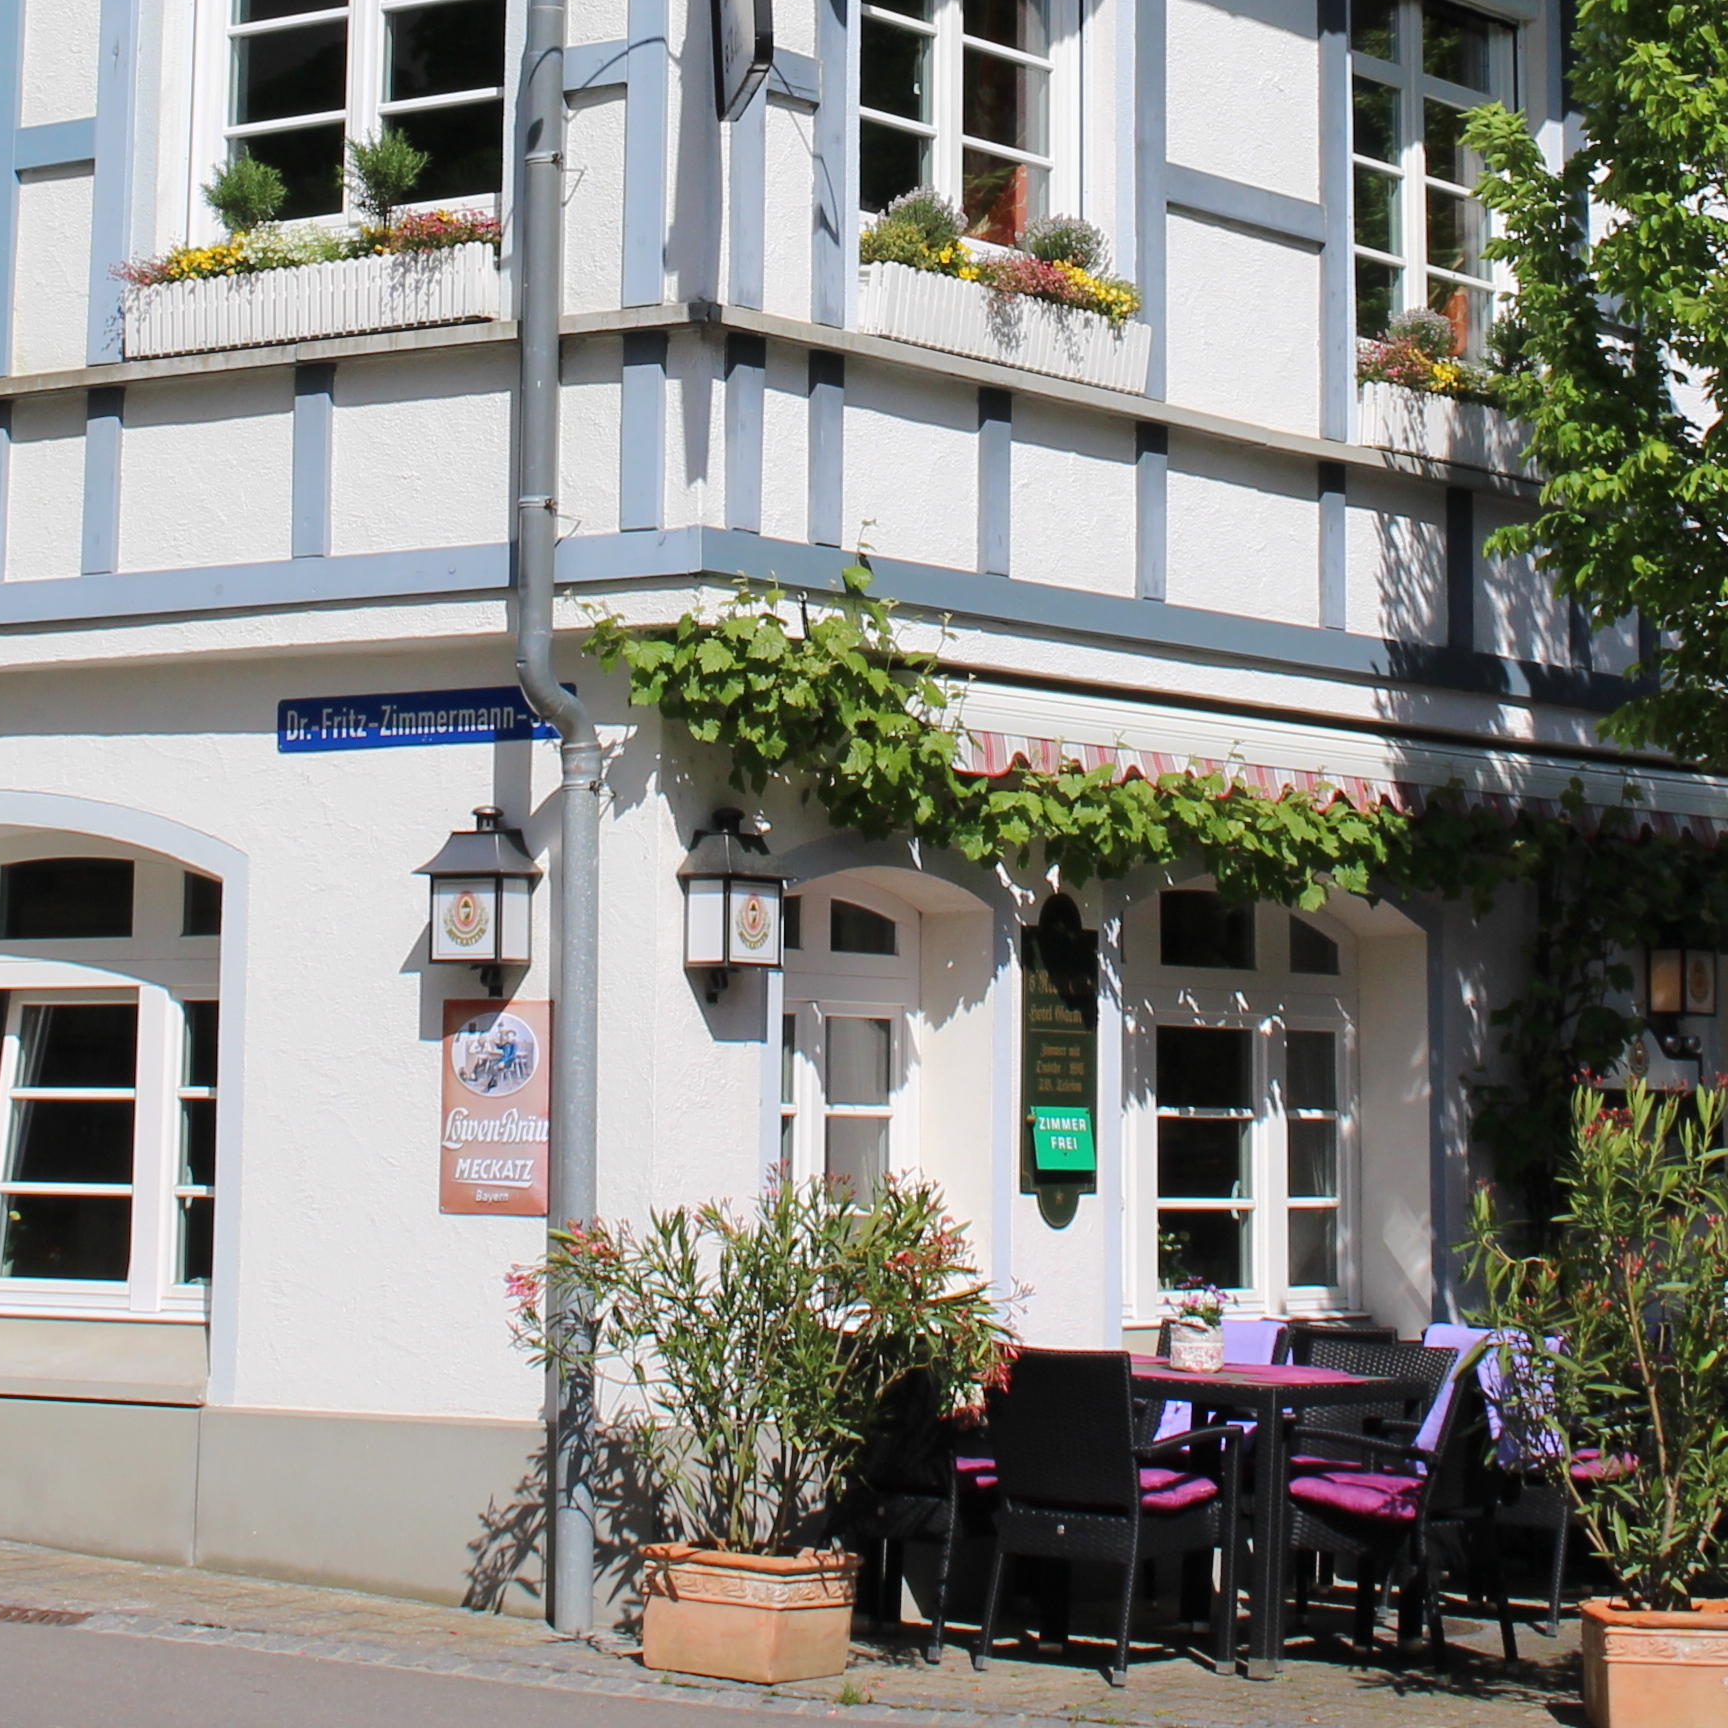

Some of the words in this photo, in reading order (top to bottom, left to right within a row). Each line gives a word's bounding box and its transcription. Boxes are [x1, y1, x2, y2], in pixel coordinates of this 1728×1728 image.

[442, 1107, 549, 1151] Löwen-Bräu
[1038, 1116, 1087, 1131] ZIMMER
[1050, 1136, 1078, 1150] FREI
[454, 1158, 534, 1180] MECKATZ
[475, 1189, 509, 1204] Bayern
